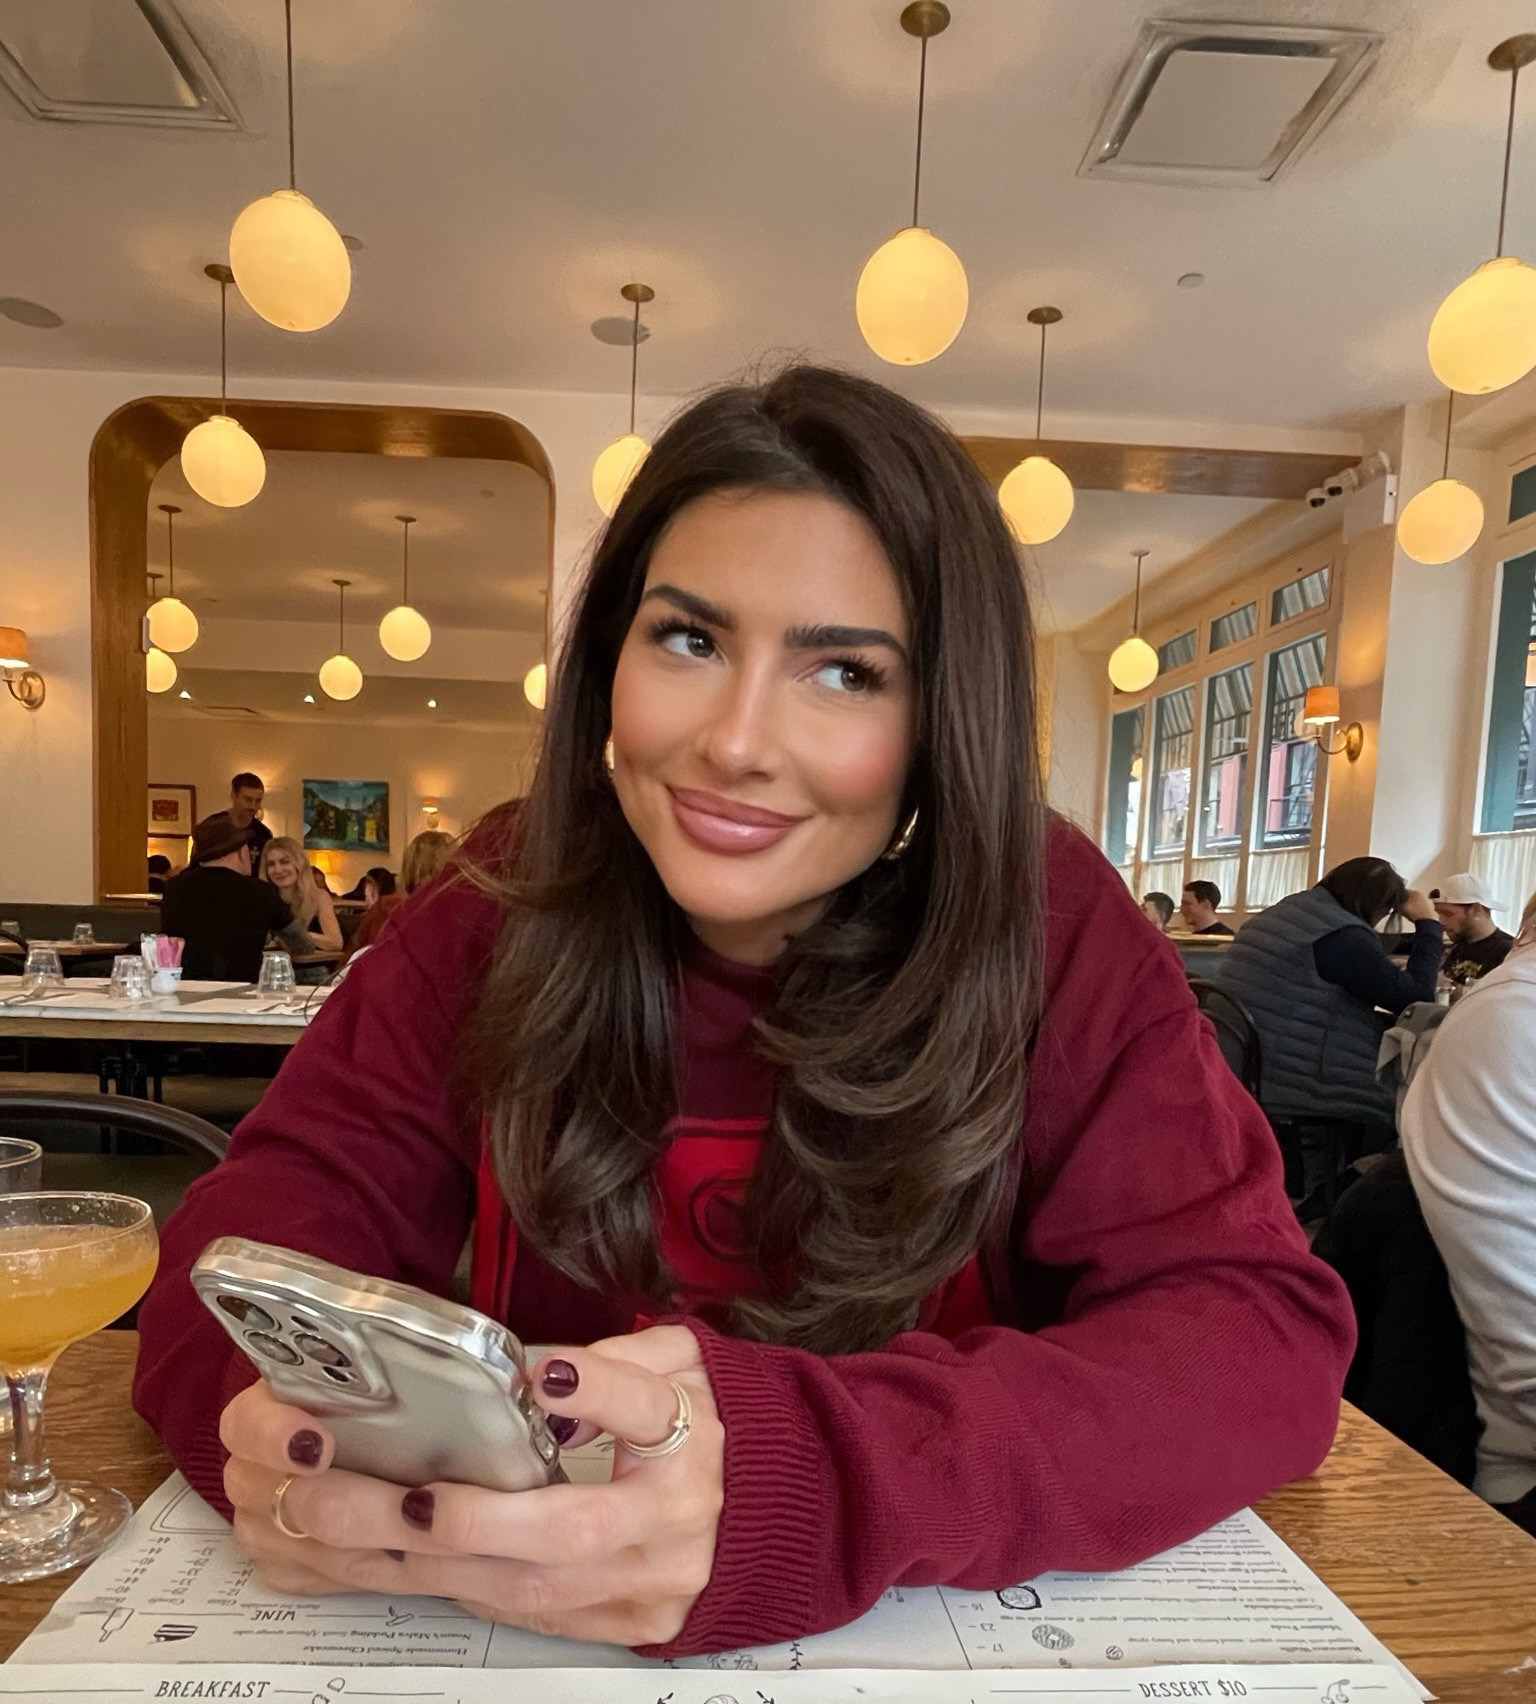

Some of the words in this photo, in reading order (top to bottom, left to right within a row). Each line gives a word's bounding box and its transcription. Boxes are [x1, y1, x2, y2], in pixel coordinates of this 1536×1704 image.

[250, 1610, 296, 1621] WINE
[155, 1680, 270, 1698] BREAKFAST
[1138, 1680, 1213, 1698] DESSERT
[1217, 1679, 1247, 1697] $10
